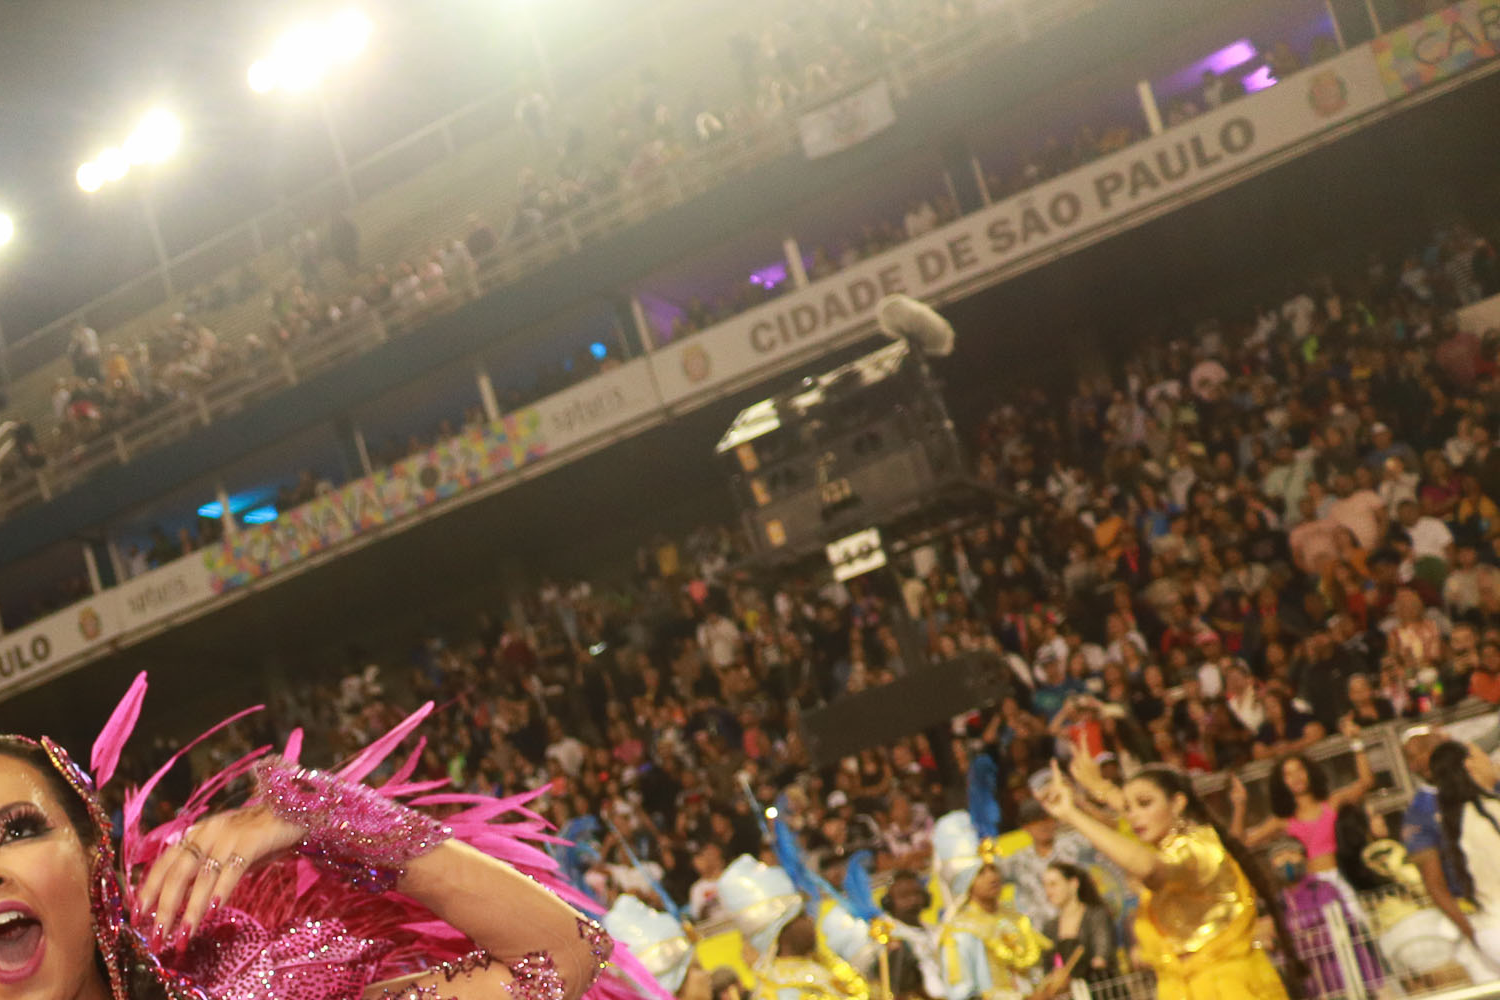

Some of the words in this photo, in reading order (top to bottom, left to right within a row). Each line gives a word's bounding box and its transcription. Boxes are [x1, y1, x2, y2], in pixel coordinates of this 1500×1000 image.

[748, 262, 908, 354] CIDADE
[916, 222, 980, 284] DE
[986, 190, 1083, 252] SÃO
[1093, 116, 1257, 210] PAULO
